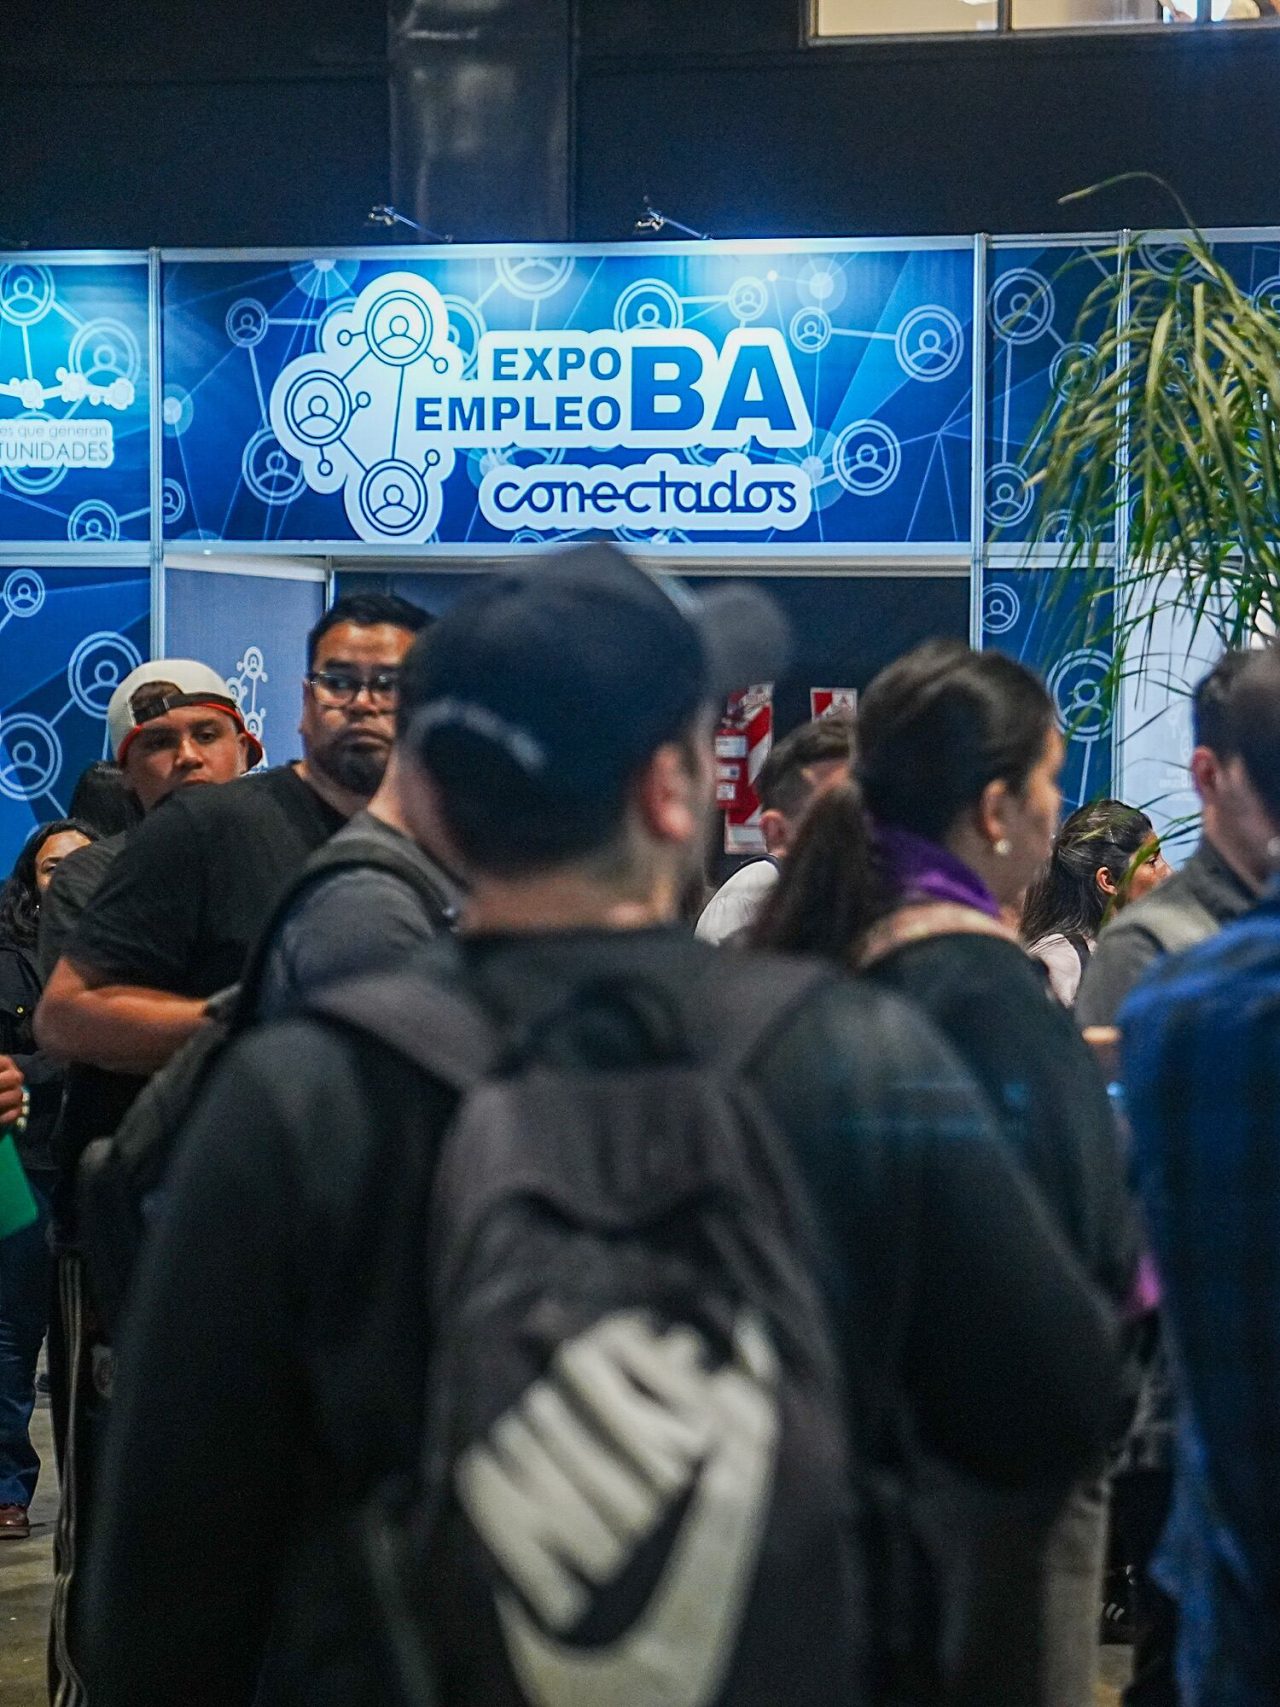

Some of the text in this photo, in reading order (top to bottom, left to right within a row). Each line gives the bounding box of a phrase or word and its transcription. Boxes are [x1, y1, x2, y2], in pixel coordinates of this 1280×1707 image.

[492, 346, 622, 381] EXPO
[630, 345, 797, 431] BA
[18, 426, 44, 439] que
[48, 426, 108, 439] generan
[415, 395, 622, 431] EMPLEO
[493, 470, 797, 514] conectados
[456, 1310, 778, 1632] NIKE
